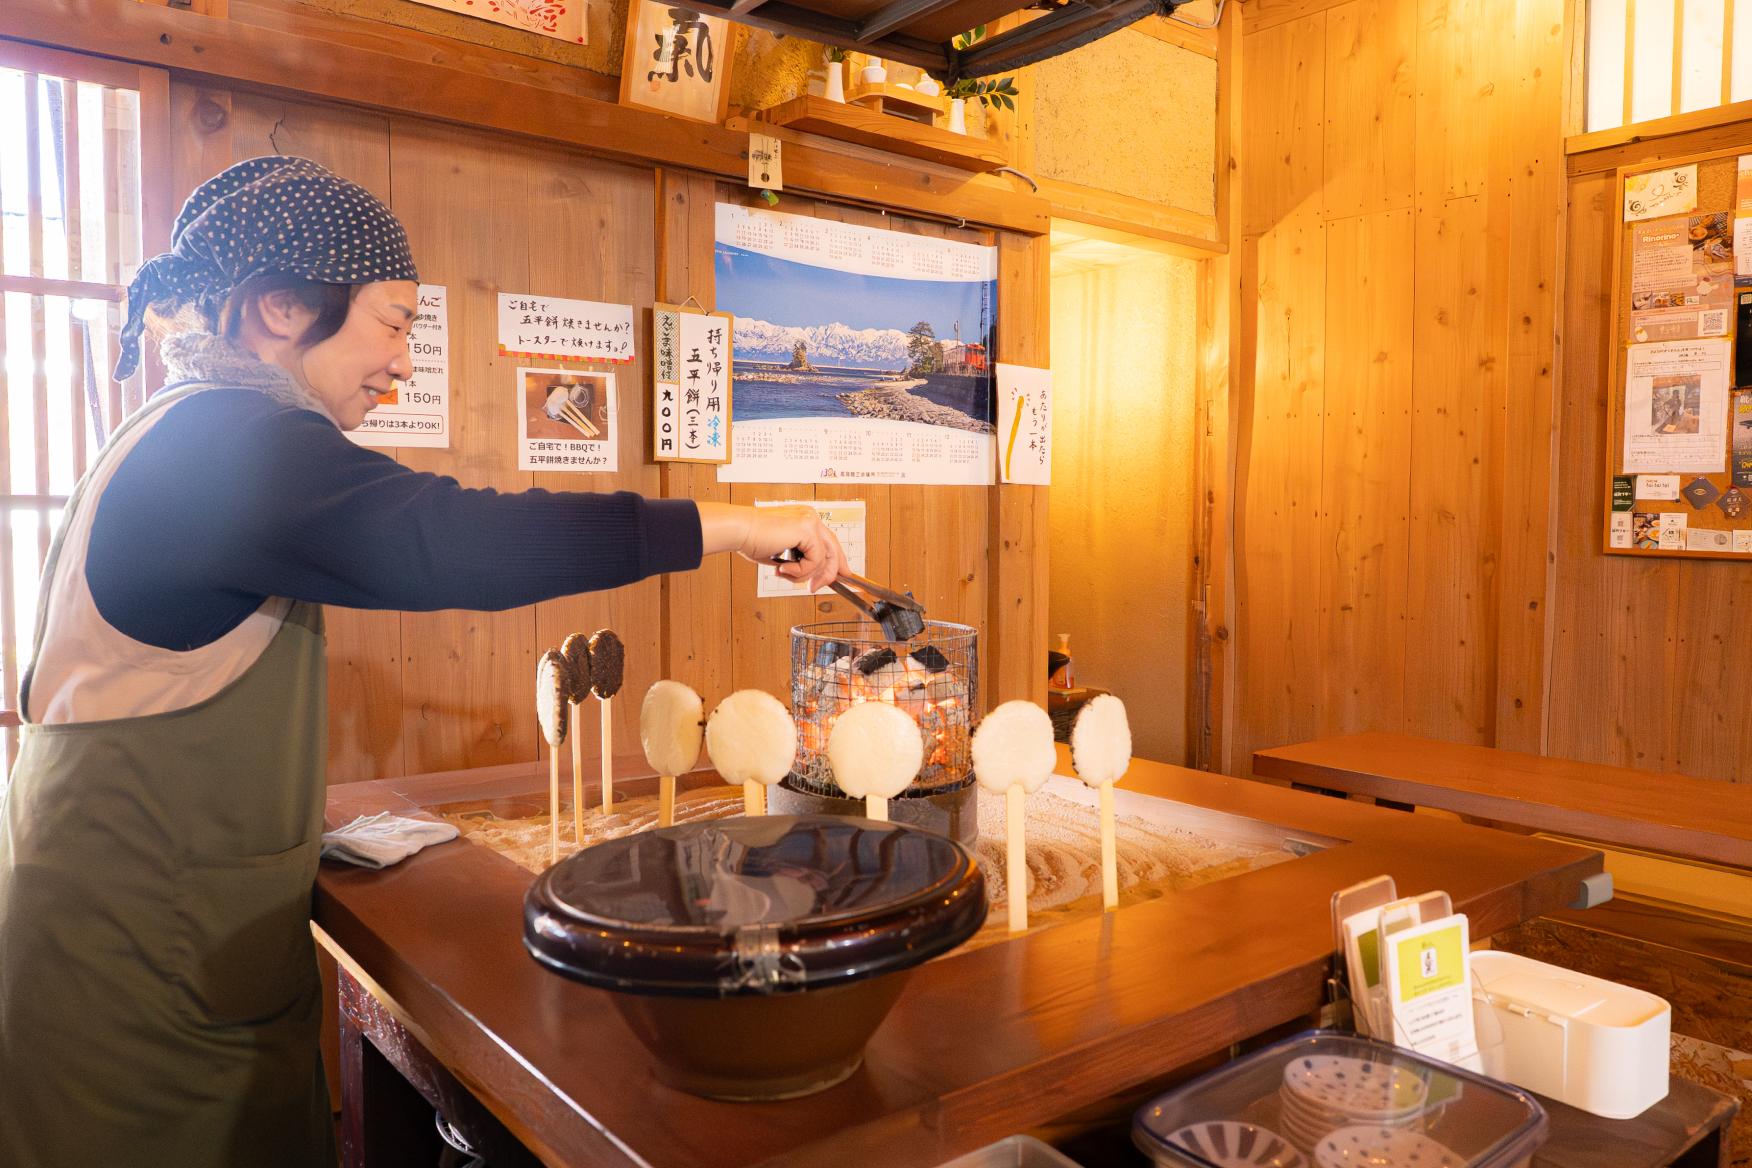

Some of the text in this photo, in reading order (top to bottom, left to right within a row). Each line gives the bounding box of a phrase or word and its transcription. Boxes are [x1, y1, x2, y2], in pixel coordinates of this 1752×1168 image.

[416, 295, 442, 308] んご
[508, 300, 549, 312] ご自宅で
[407, 343, 442, 356] 150円
[404, 392, 442, 405] 150円
[1028, 408, 1038, 450] もう一本
[529, 455, 607, 465] 五平餅焼きませんか？
